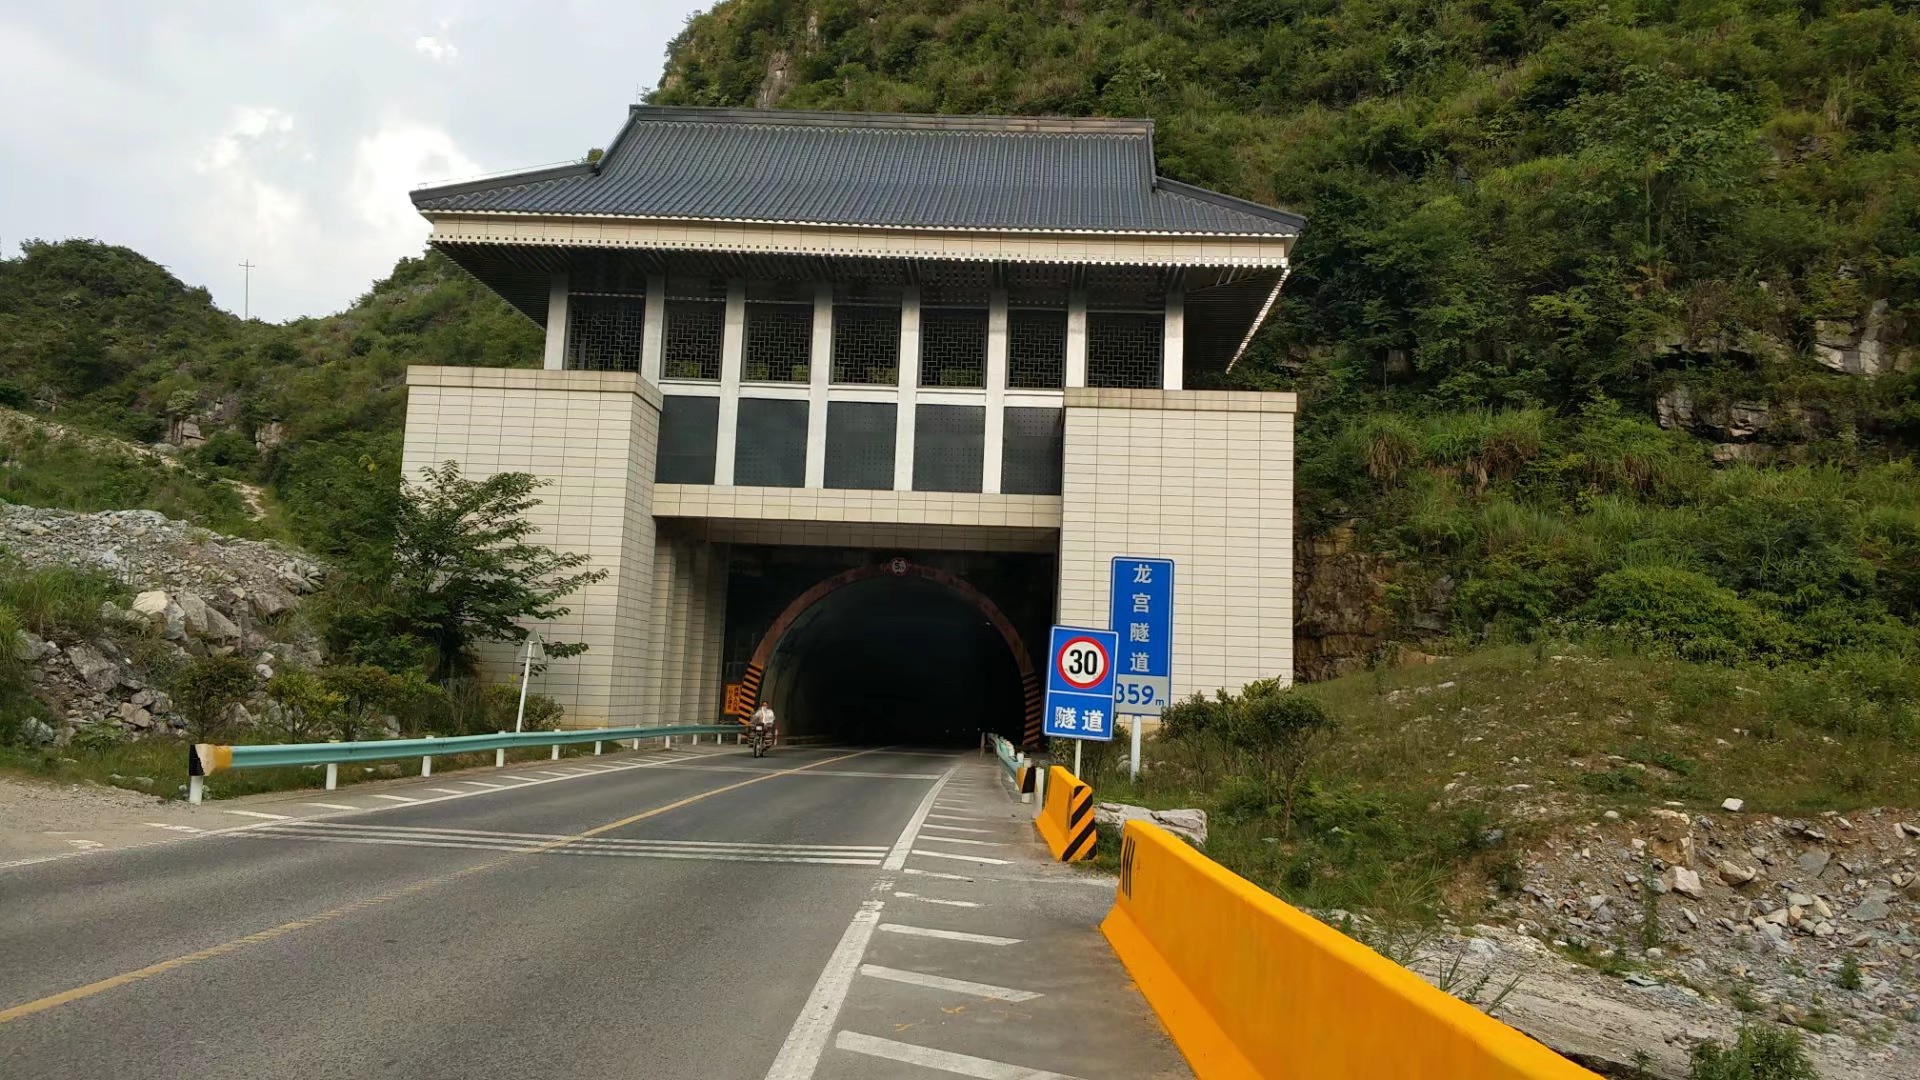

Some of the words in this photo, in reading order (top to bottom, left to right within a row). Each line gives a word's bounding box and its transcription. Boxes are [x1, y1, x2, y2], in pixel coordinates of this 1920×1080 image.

[1130, 564, 1152, 672] 龙宫隧道
[1069, 649, 1098, 675] 30
[1055, 707, 1104, 733] 隧道
